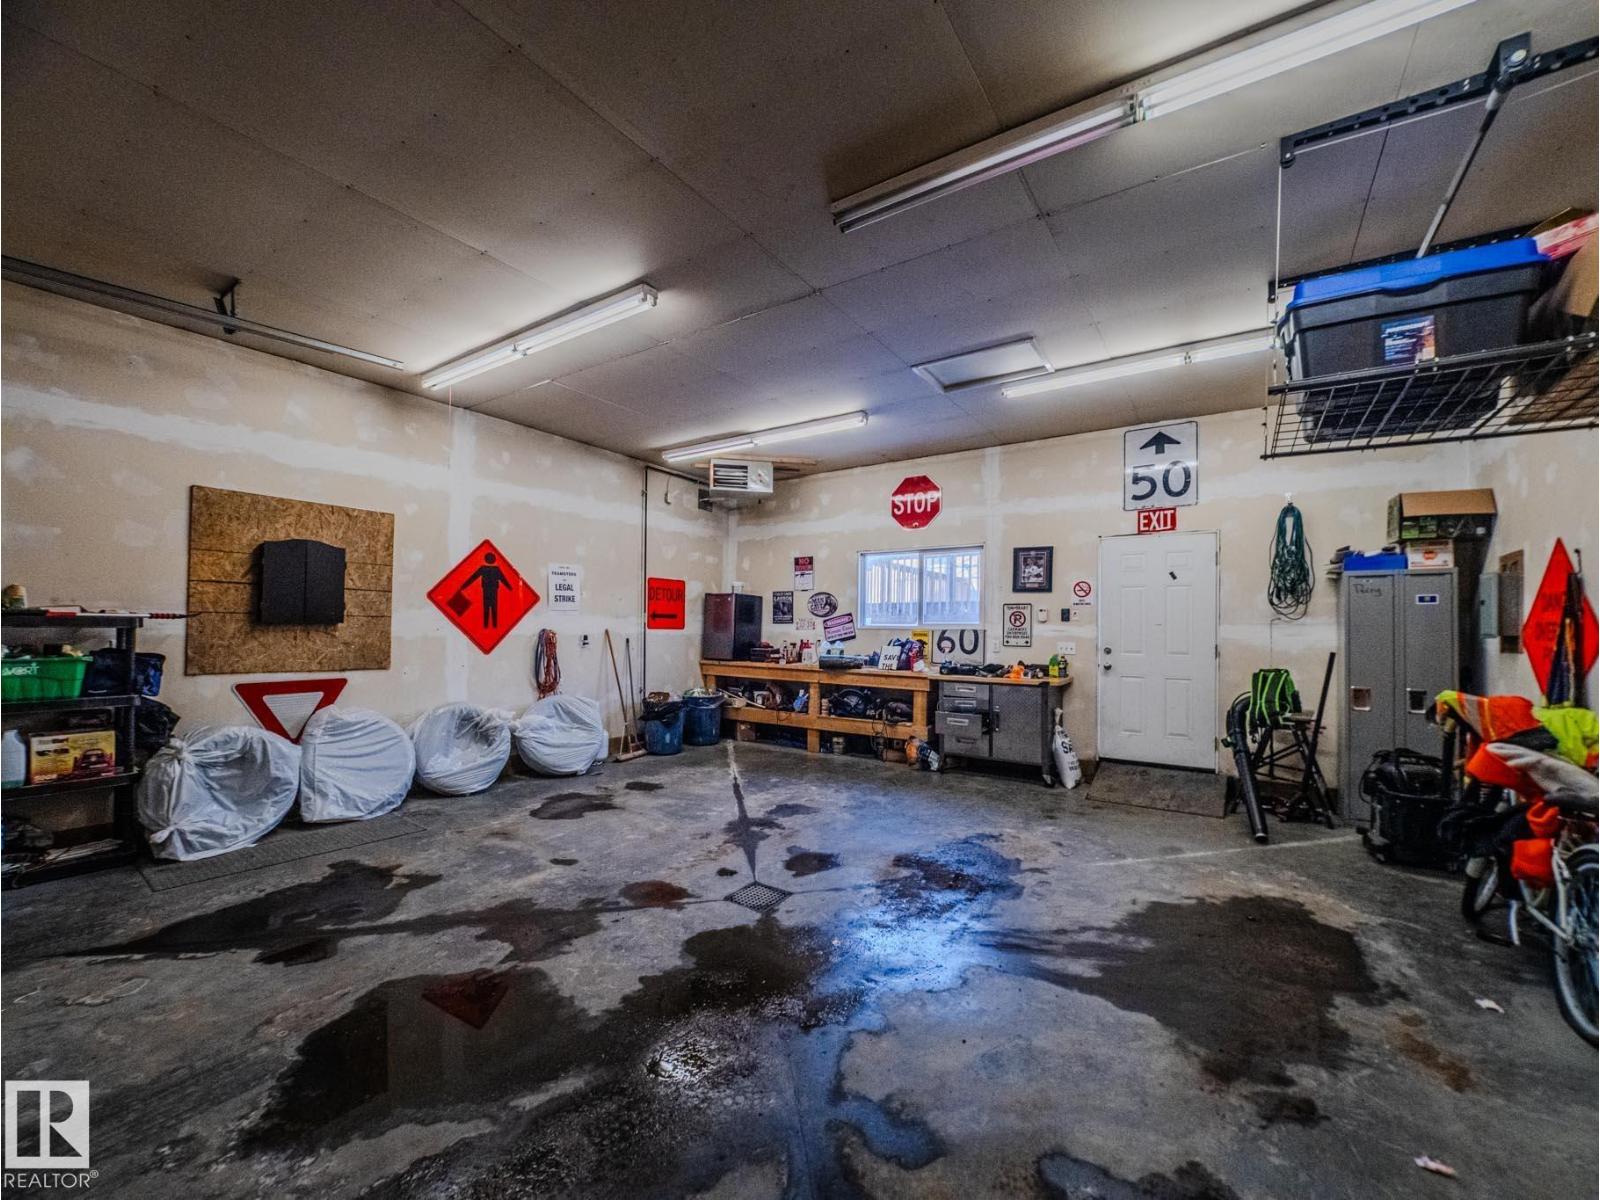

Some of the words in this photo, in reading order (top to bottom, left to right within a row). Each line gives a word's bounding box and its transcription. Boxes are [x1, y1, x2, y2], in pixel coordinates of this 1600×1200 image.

[1131, 460, 1192, 501] 50
[893, 490, 938, 515] STOP
[1140, 509, 1175, 532] EXIT
[554, 594, 576, 603] STRIKE
[555, 583, 574, 592] LEGAL
[649, 586, 684, 604] DETOUR
[937, 629, 979, 655] 60
